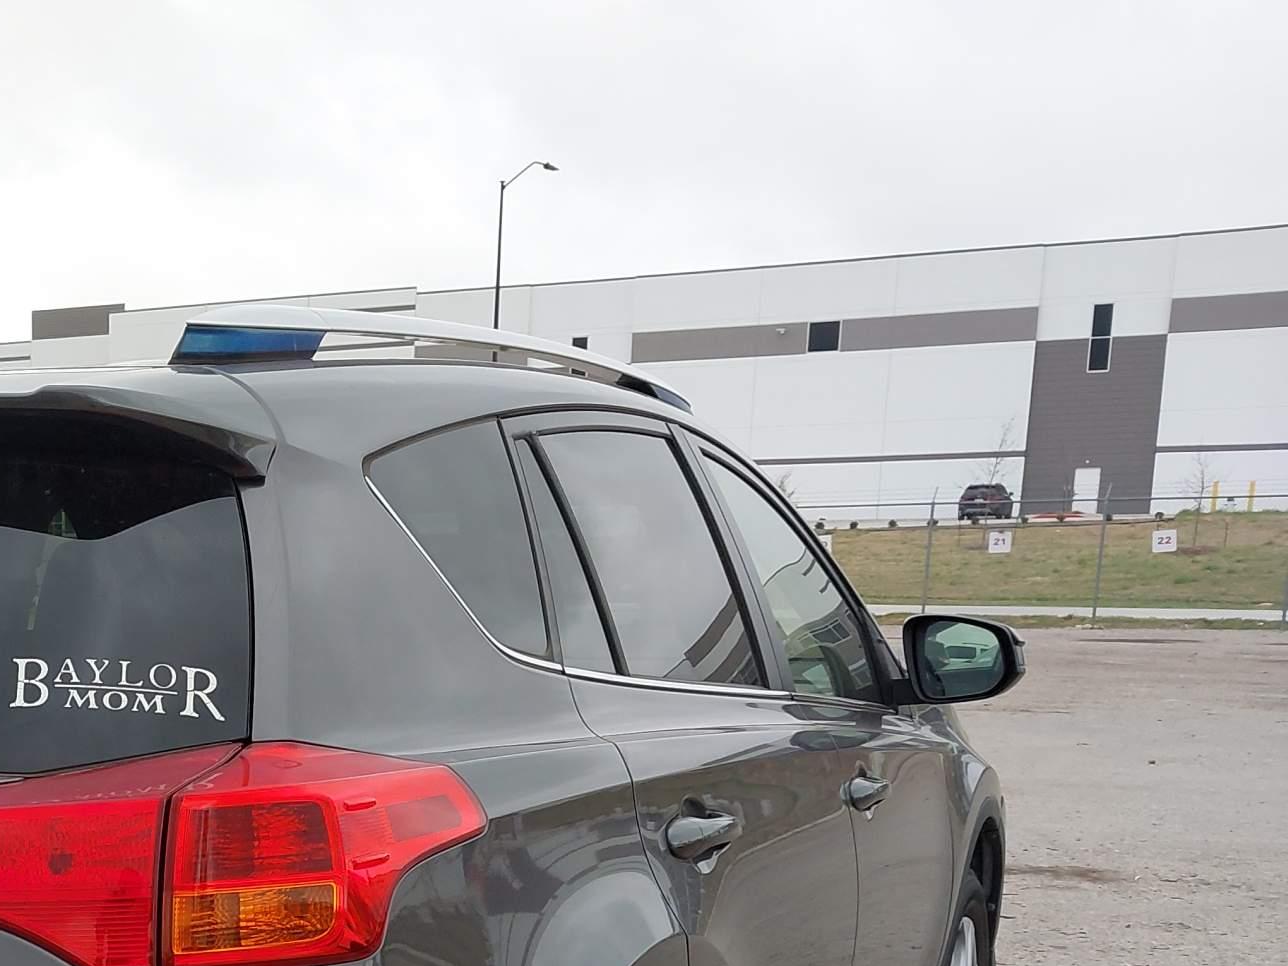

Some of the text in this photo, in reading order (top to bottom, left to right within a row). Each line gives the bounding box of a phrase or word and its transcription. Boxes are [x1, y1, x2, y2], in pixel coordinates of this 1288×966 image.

[992, 537, 1006, 546] 21
[1157, 536, 1172, 545] 22
[9, 657, 226, 722] BAYLOR
[63, 688, 167, 715] MOM
